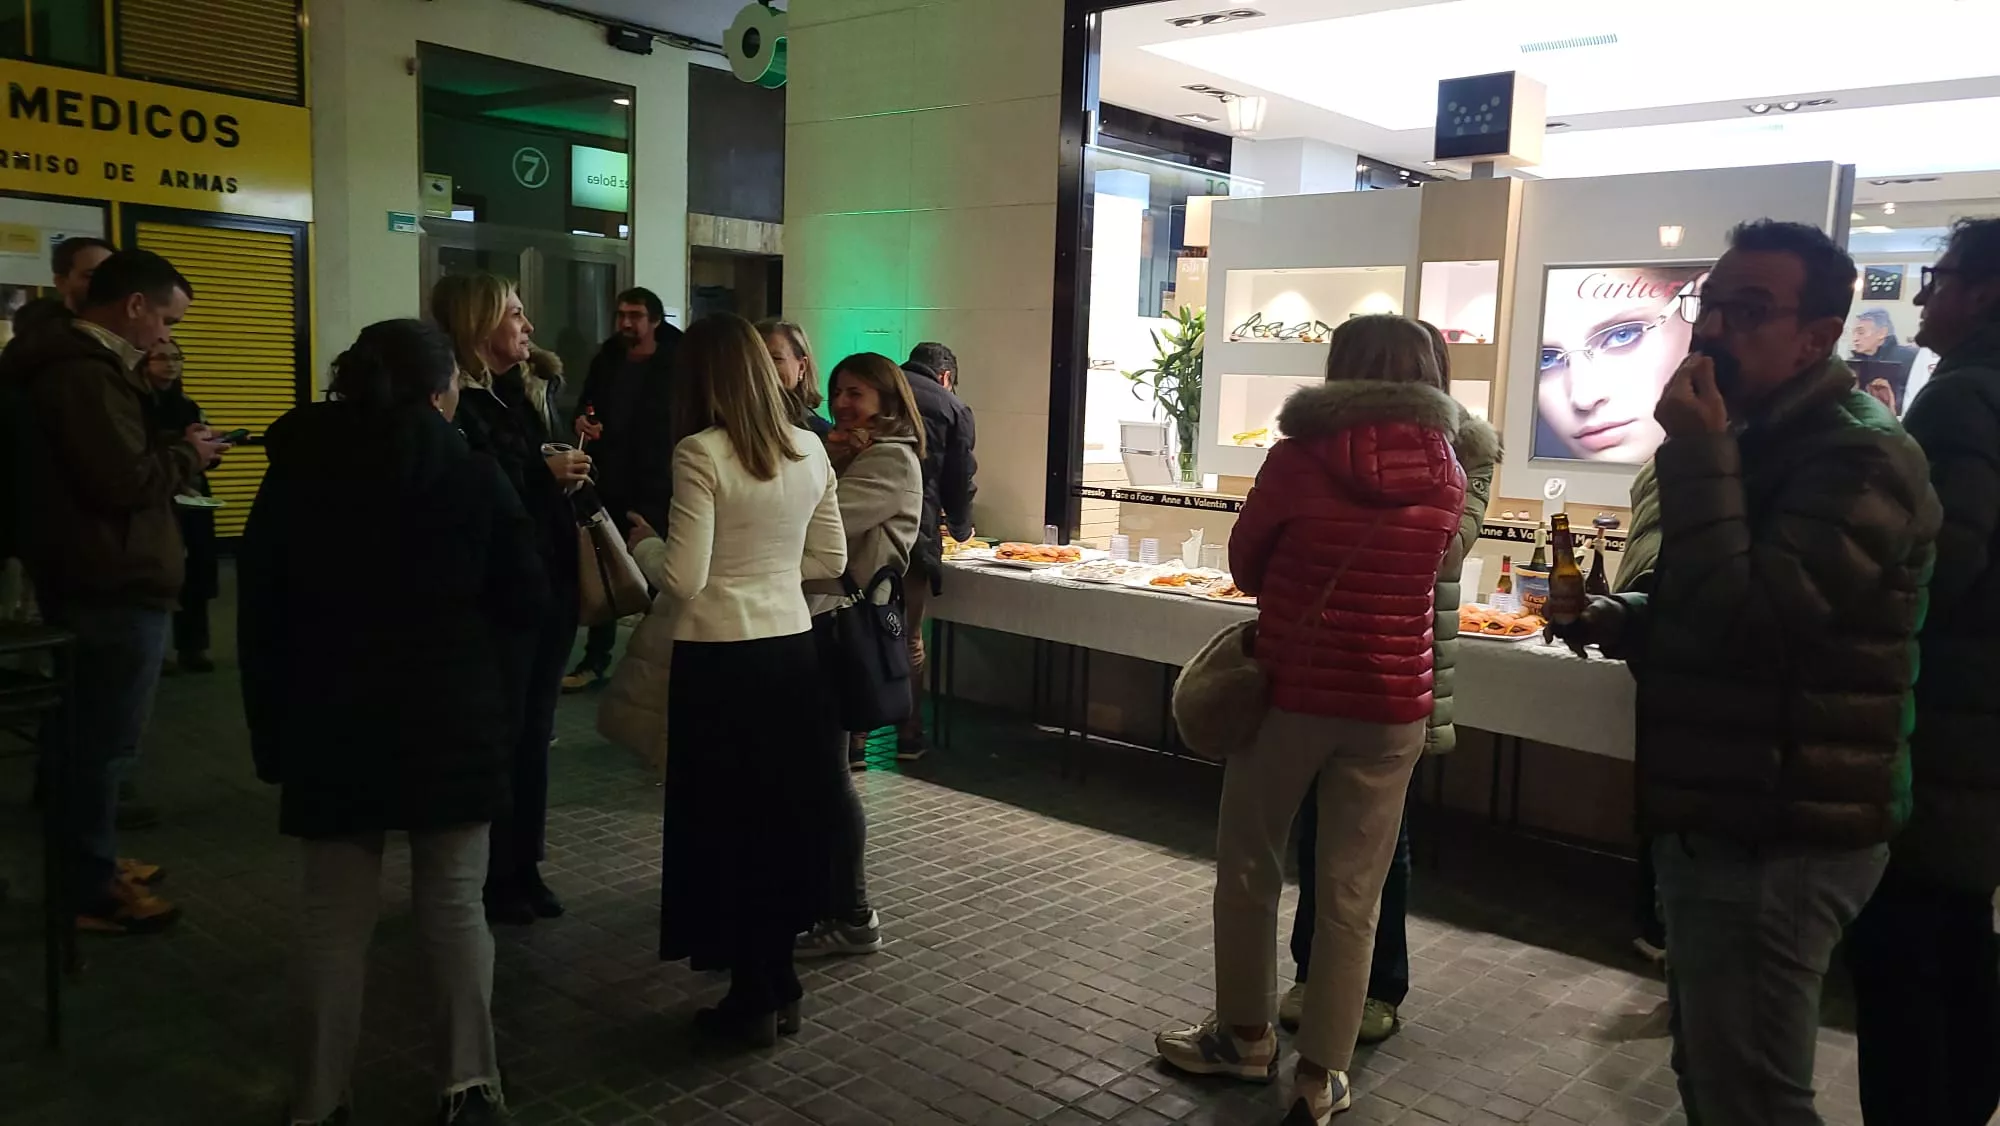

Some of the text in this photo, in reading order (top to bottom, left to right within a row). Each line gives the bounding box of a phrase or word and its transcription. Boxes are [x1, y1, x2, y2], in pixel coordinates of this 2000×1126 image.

[8, 81, 240, 148] MEDICOS
[104, 162, 136, 182] DE
[159, 169, 238, 194] ARMAS
[522, 154, 540, 182] 7
[1577, 272, 1685, 299] Cartier
[1136, 492, 1154, 502] Face
[1161, 494, 1181, 505] Anne
[1184, 496, 1193, 506] &
[1193, 498, 1228, 509] Valentin
[1507, 527, 1517, 538] &
